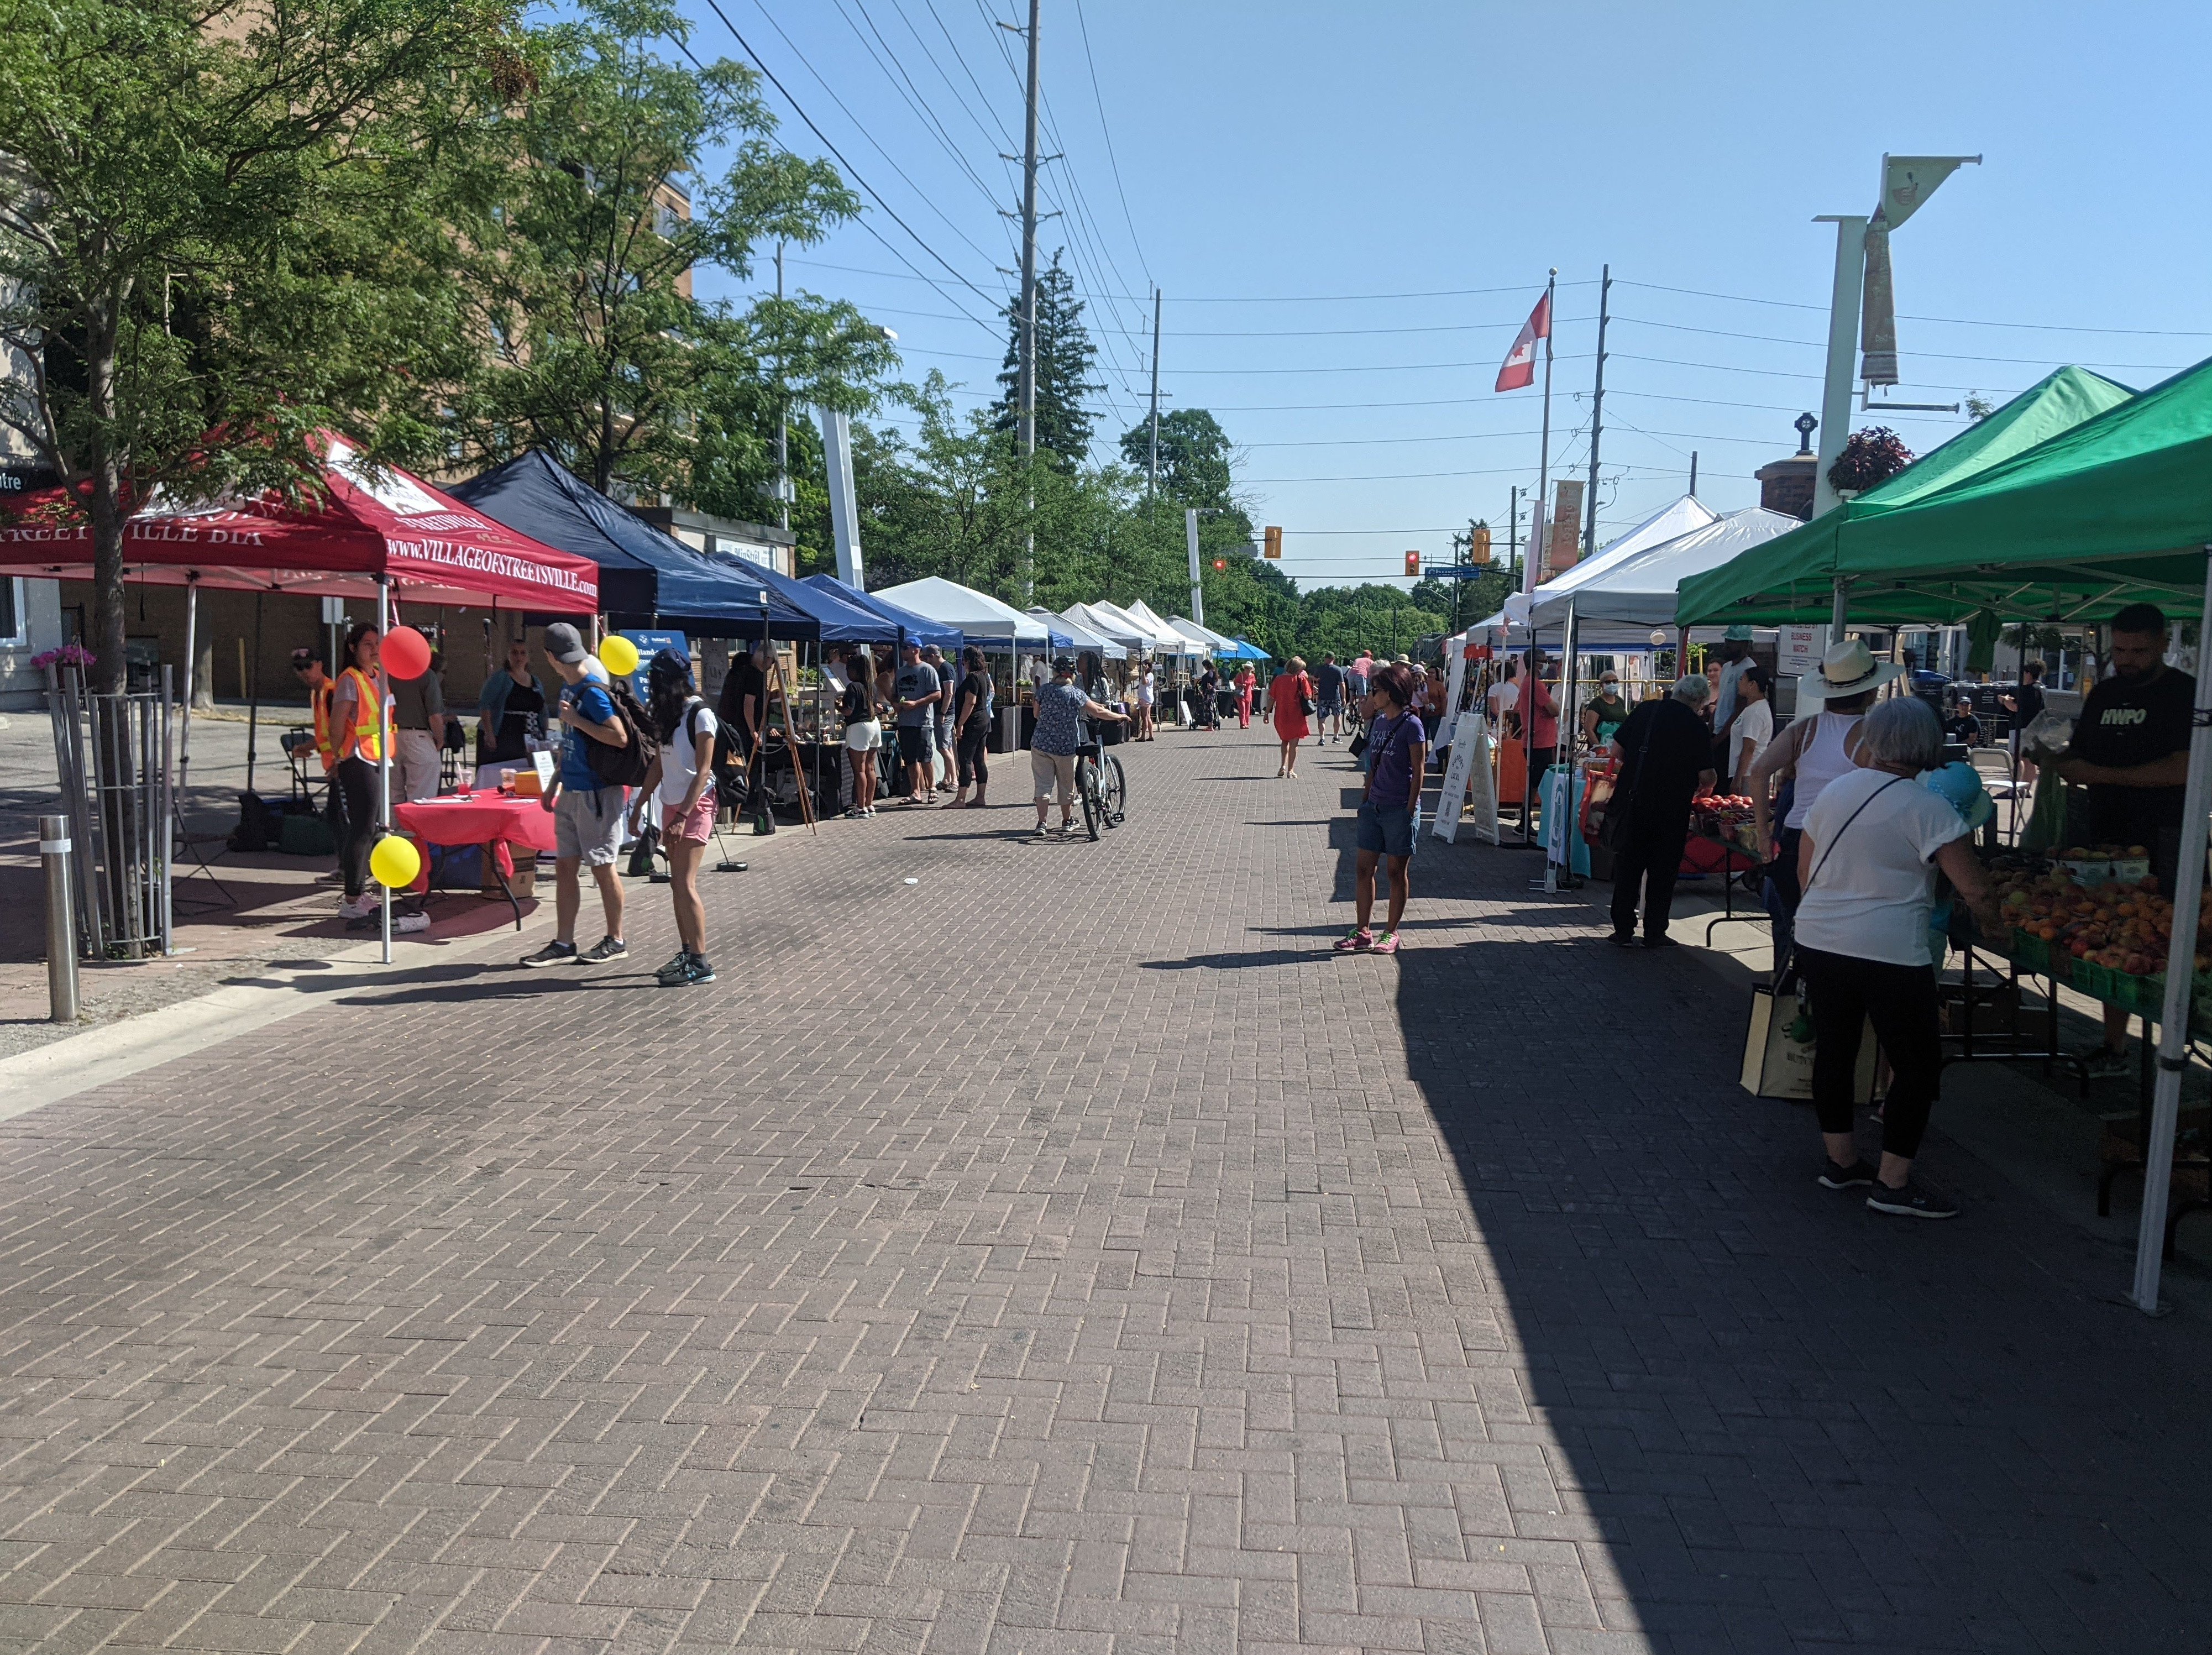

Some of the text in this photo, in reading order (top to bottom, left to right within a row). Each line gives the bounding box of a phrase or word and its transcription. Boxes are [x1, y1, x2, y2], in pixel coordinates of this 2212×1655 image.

[0, 472, 21, 490] tre
[387, 538, 597, 597] www.VILLAGEOFSTREETSVILLE.com
[1791, 632, 1812, 641] BUSINESS
